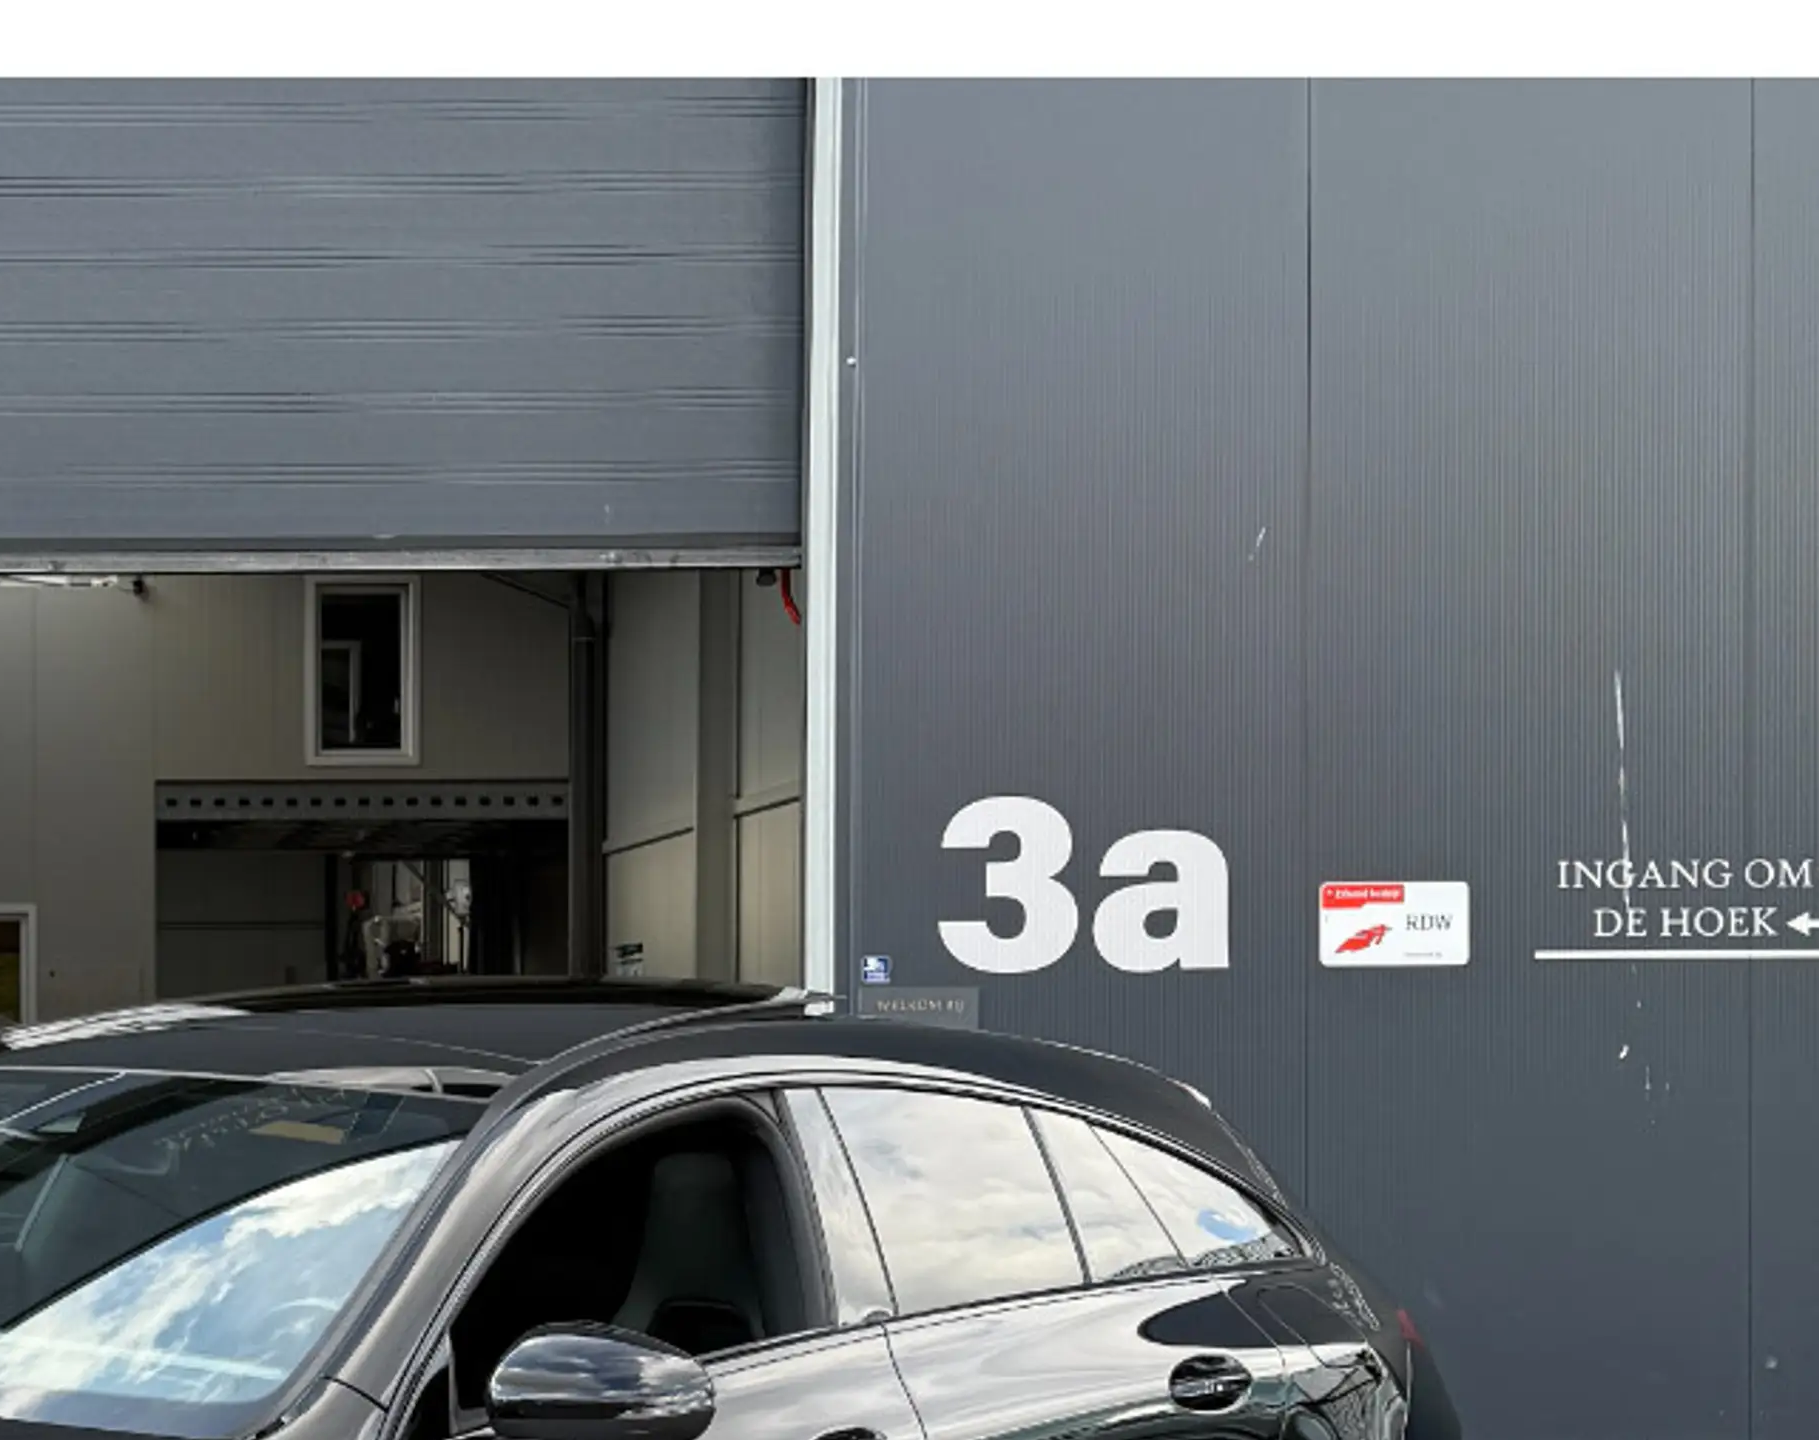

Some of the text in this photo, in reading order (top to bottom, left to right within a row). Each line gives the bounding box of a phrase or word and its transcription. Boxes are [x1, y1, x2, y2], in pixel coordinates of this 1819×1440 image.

[937, 796, 1229, 973] 3a
[1557, 858, 1814, 889] INGANG OM
[1406, 913, 1453, 931] RDW
[1593, 906, 1779, 937] DE HOEK
